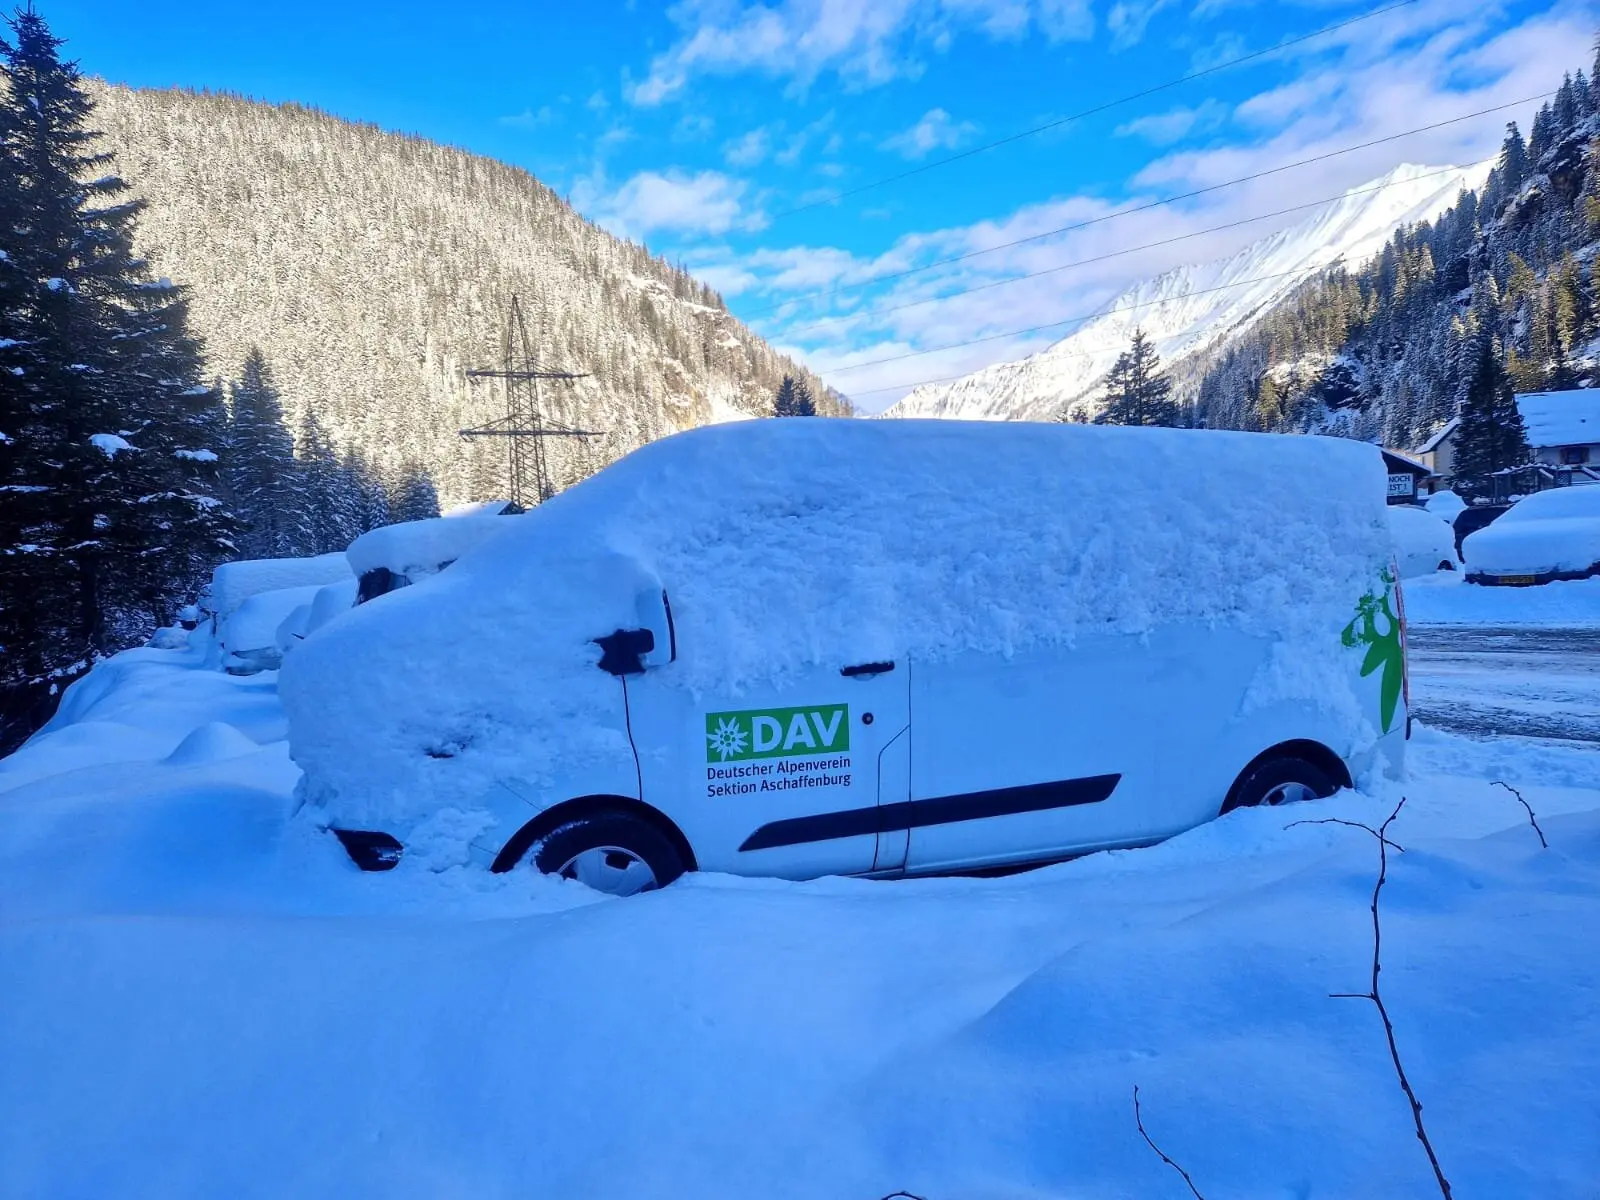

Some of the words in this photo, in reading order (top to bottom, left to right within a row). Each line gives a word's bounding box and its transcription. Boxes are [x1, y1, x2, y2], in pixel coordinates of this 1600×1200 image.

[752, 710, 843, 753] DAV
[707, 764, 774, 780] Deutscher
[777, 756, 850, 775] Alpenverein
[707, 782, 756, 797] Sektion
[760, 774, 851, 792] Aschaffenburg
